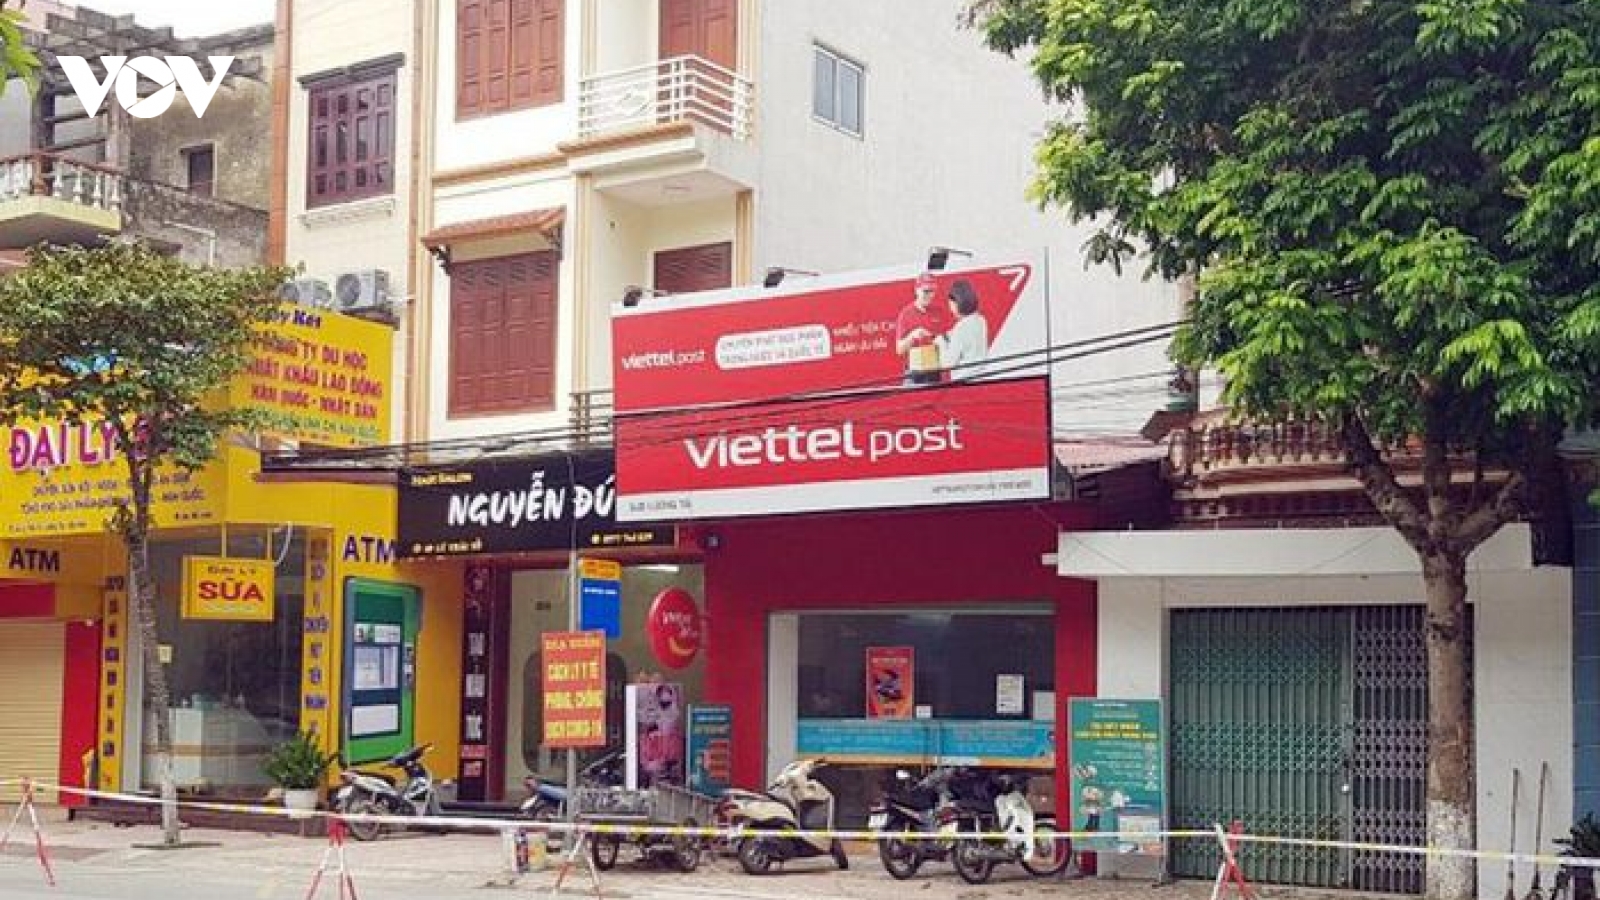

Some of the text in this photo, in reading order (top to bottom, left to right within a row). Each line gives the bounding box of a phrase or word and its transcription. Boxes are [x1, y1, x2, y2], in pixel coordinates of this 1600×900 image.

[684, 417, 963, 469] viettel post
[448, 470, 565, 527] NGUYỄN
[9, 547, 60, 572] ATM
[344, 535, 397, 563] ATM
[199, 576, 264, 601] SỮA
